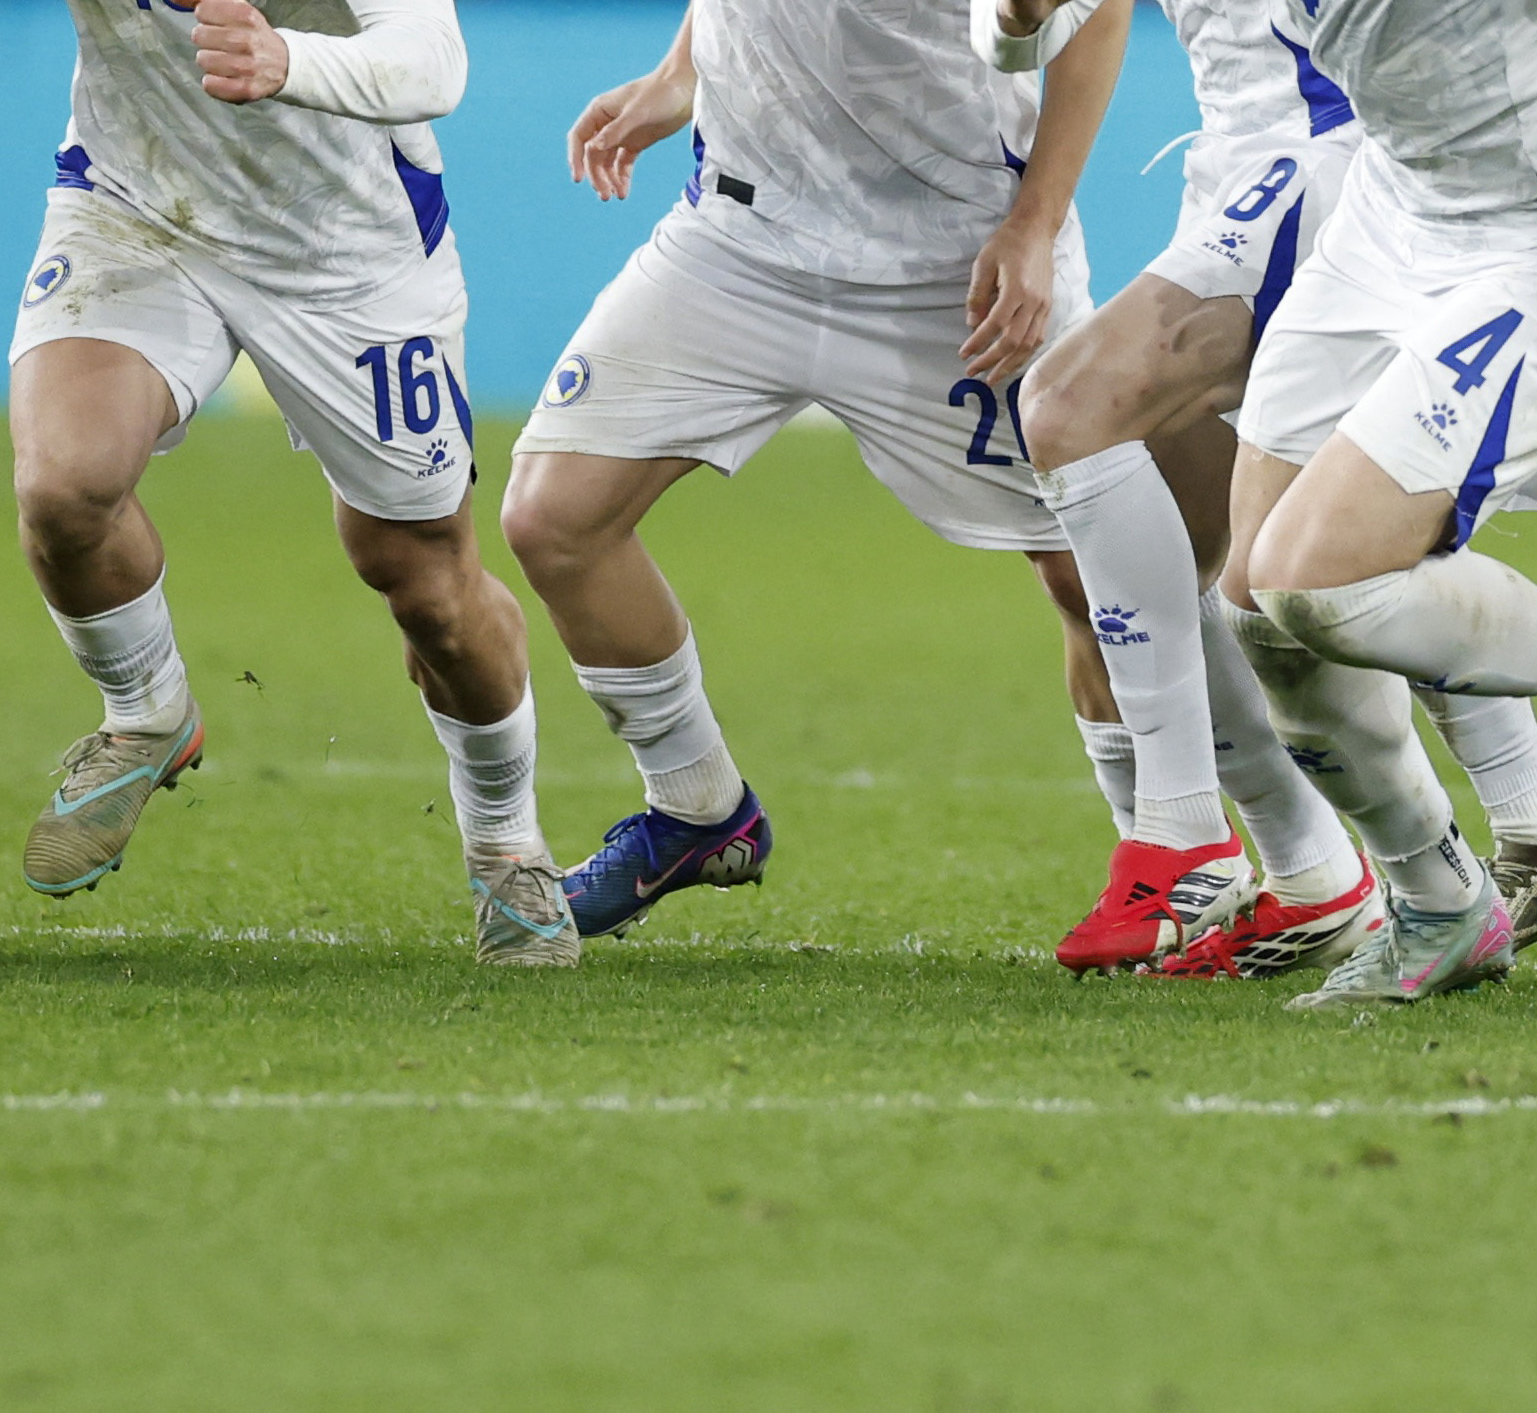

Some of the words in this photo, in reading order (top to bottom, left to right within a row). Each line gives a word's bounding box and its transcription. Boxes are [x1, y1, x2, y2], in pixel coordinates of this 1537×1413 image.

[1223, 157, 1298, 222] 8
[1202, 242, 1244, 267] KELME
[1436, 308, 1525, 396] 4
[355, 336, 441, 442] 16
[1415, 412, 1452, 452] KELME
[417, 456, 457, 478] KELME
